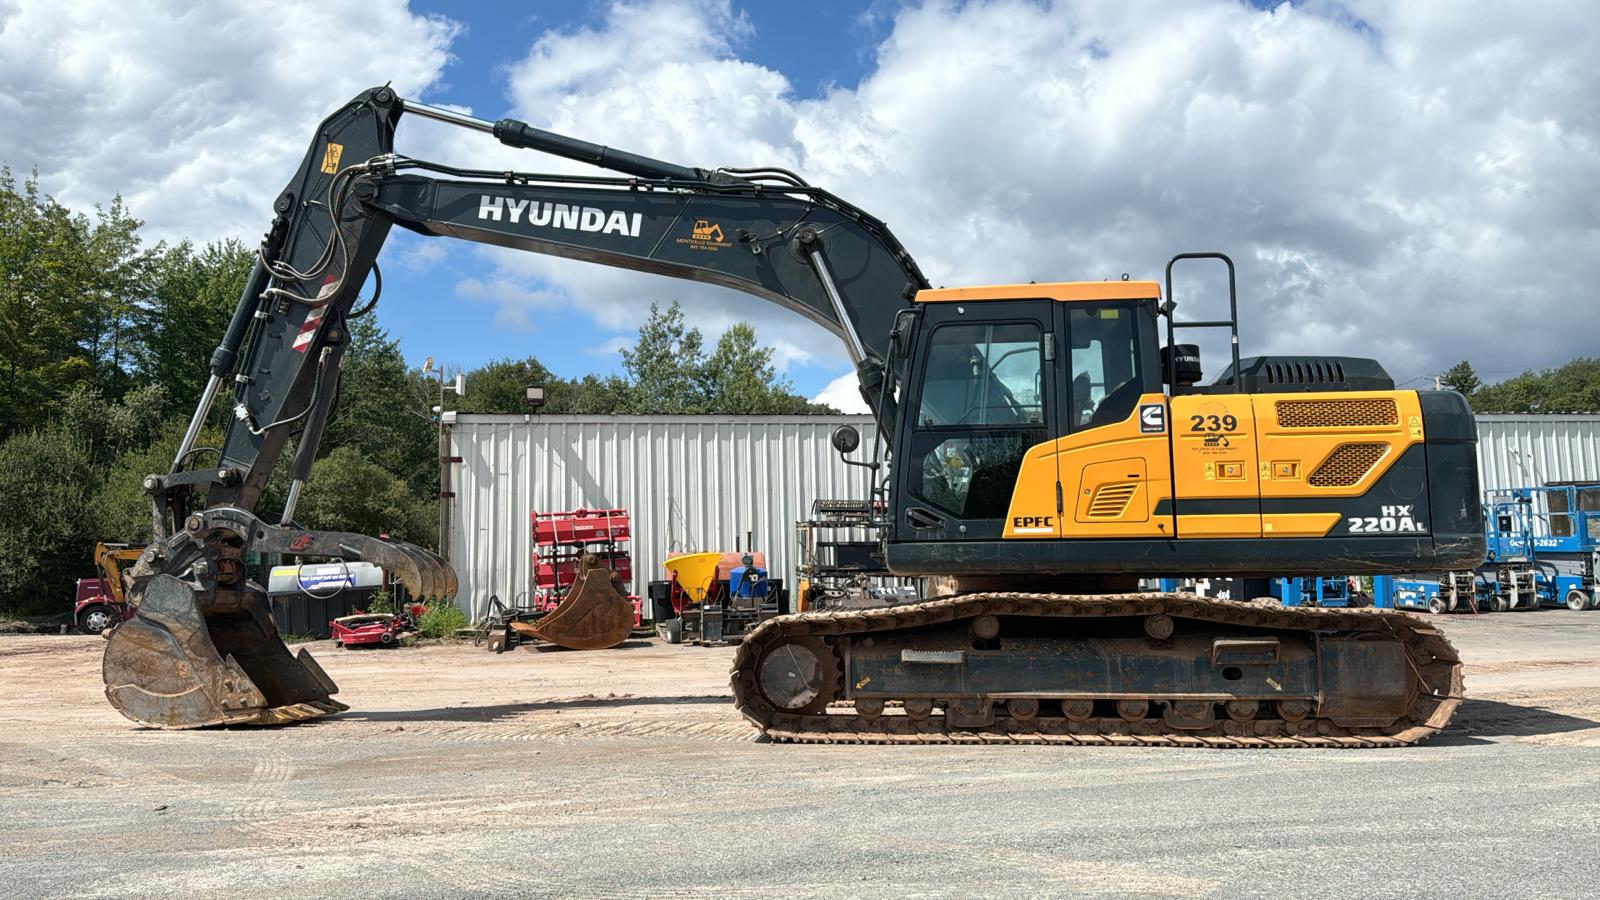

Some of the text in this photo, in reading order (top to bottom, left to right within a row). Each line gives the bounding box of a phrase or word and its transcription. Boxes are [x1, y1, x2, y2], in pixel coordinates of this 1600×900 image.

[478, 195, 642, 237] HYUNDAI
[1190, 415, 1237, 431] 239
[1381, 505, 1411, 516] HX
[1013, 516, 1054, 527] EPFC
